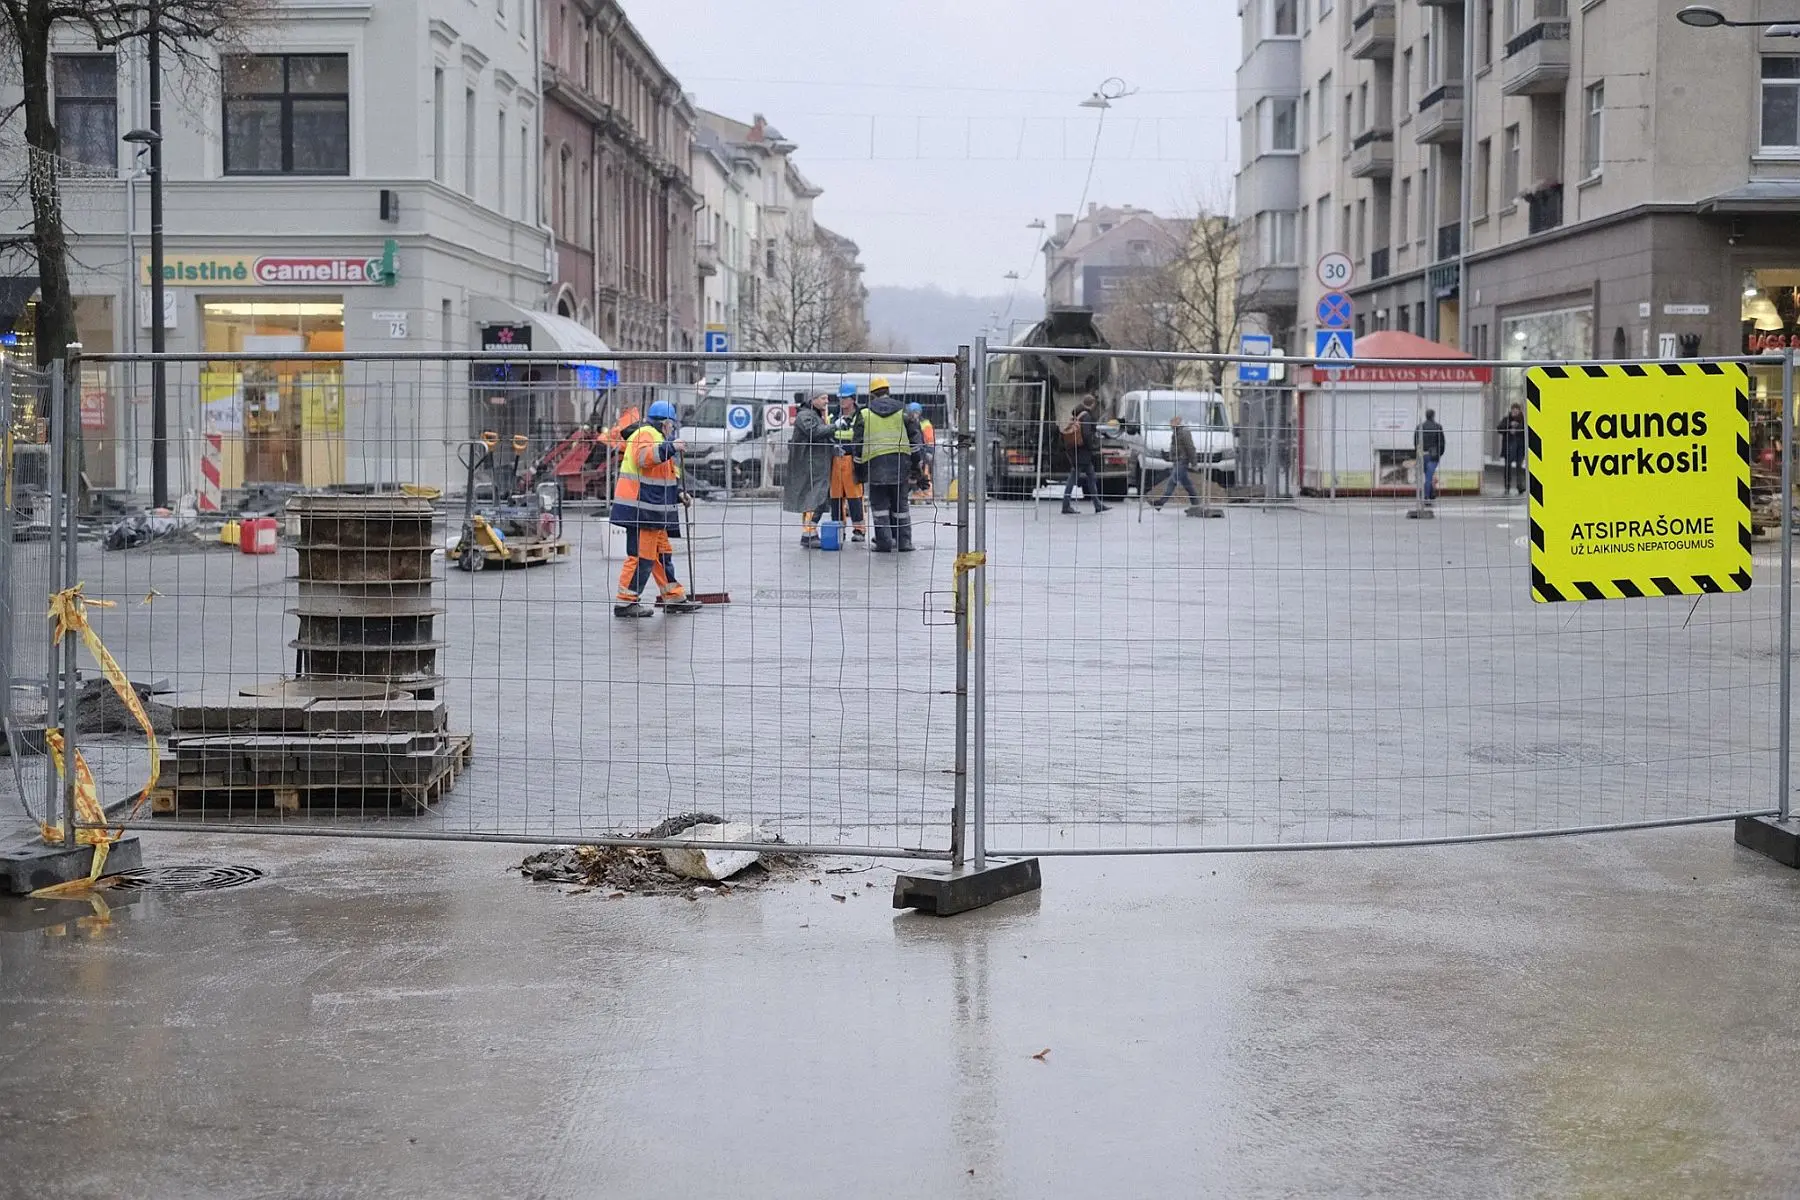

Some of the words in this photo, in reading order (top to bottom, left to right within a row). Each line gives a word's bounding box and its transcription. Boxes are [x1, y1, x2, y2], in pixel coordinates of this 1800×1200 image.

[261, 261, 363, 281] camelia
[1325, 263, 1346, 279] 30
[391, 322, 405, 337] 75
[712, 333, 727, 352] P
[1660, 337, 1675, 358] 77
[1344, 367, 1417, 381] LIETUVOS
[1420, 367, 1476, 381] SPAUDA
[1570, 410, 1708, 441] Kaunas
[1570, 443, 1708, 477] tvarkosi!
[1570, 514, 1715, 540] ATSIPRAŠOME
[1570, 543, 1585, 556] UŽ
[1587, 543, 1635, 555] LAIKINUS
[1637, 539, 1715, 553] NEPATOGUMUS
